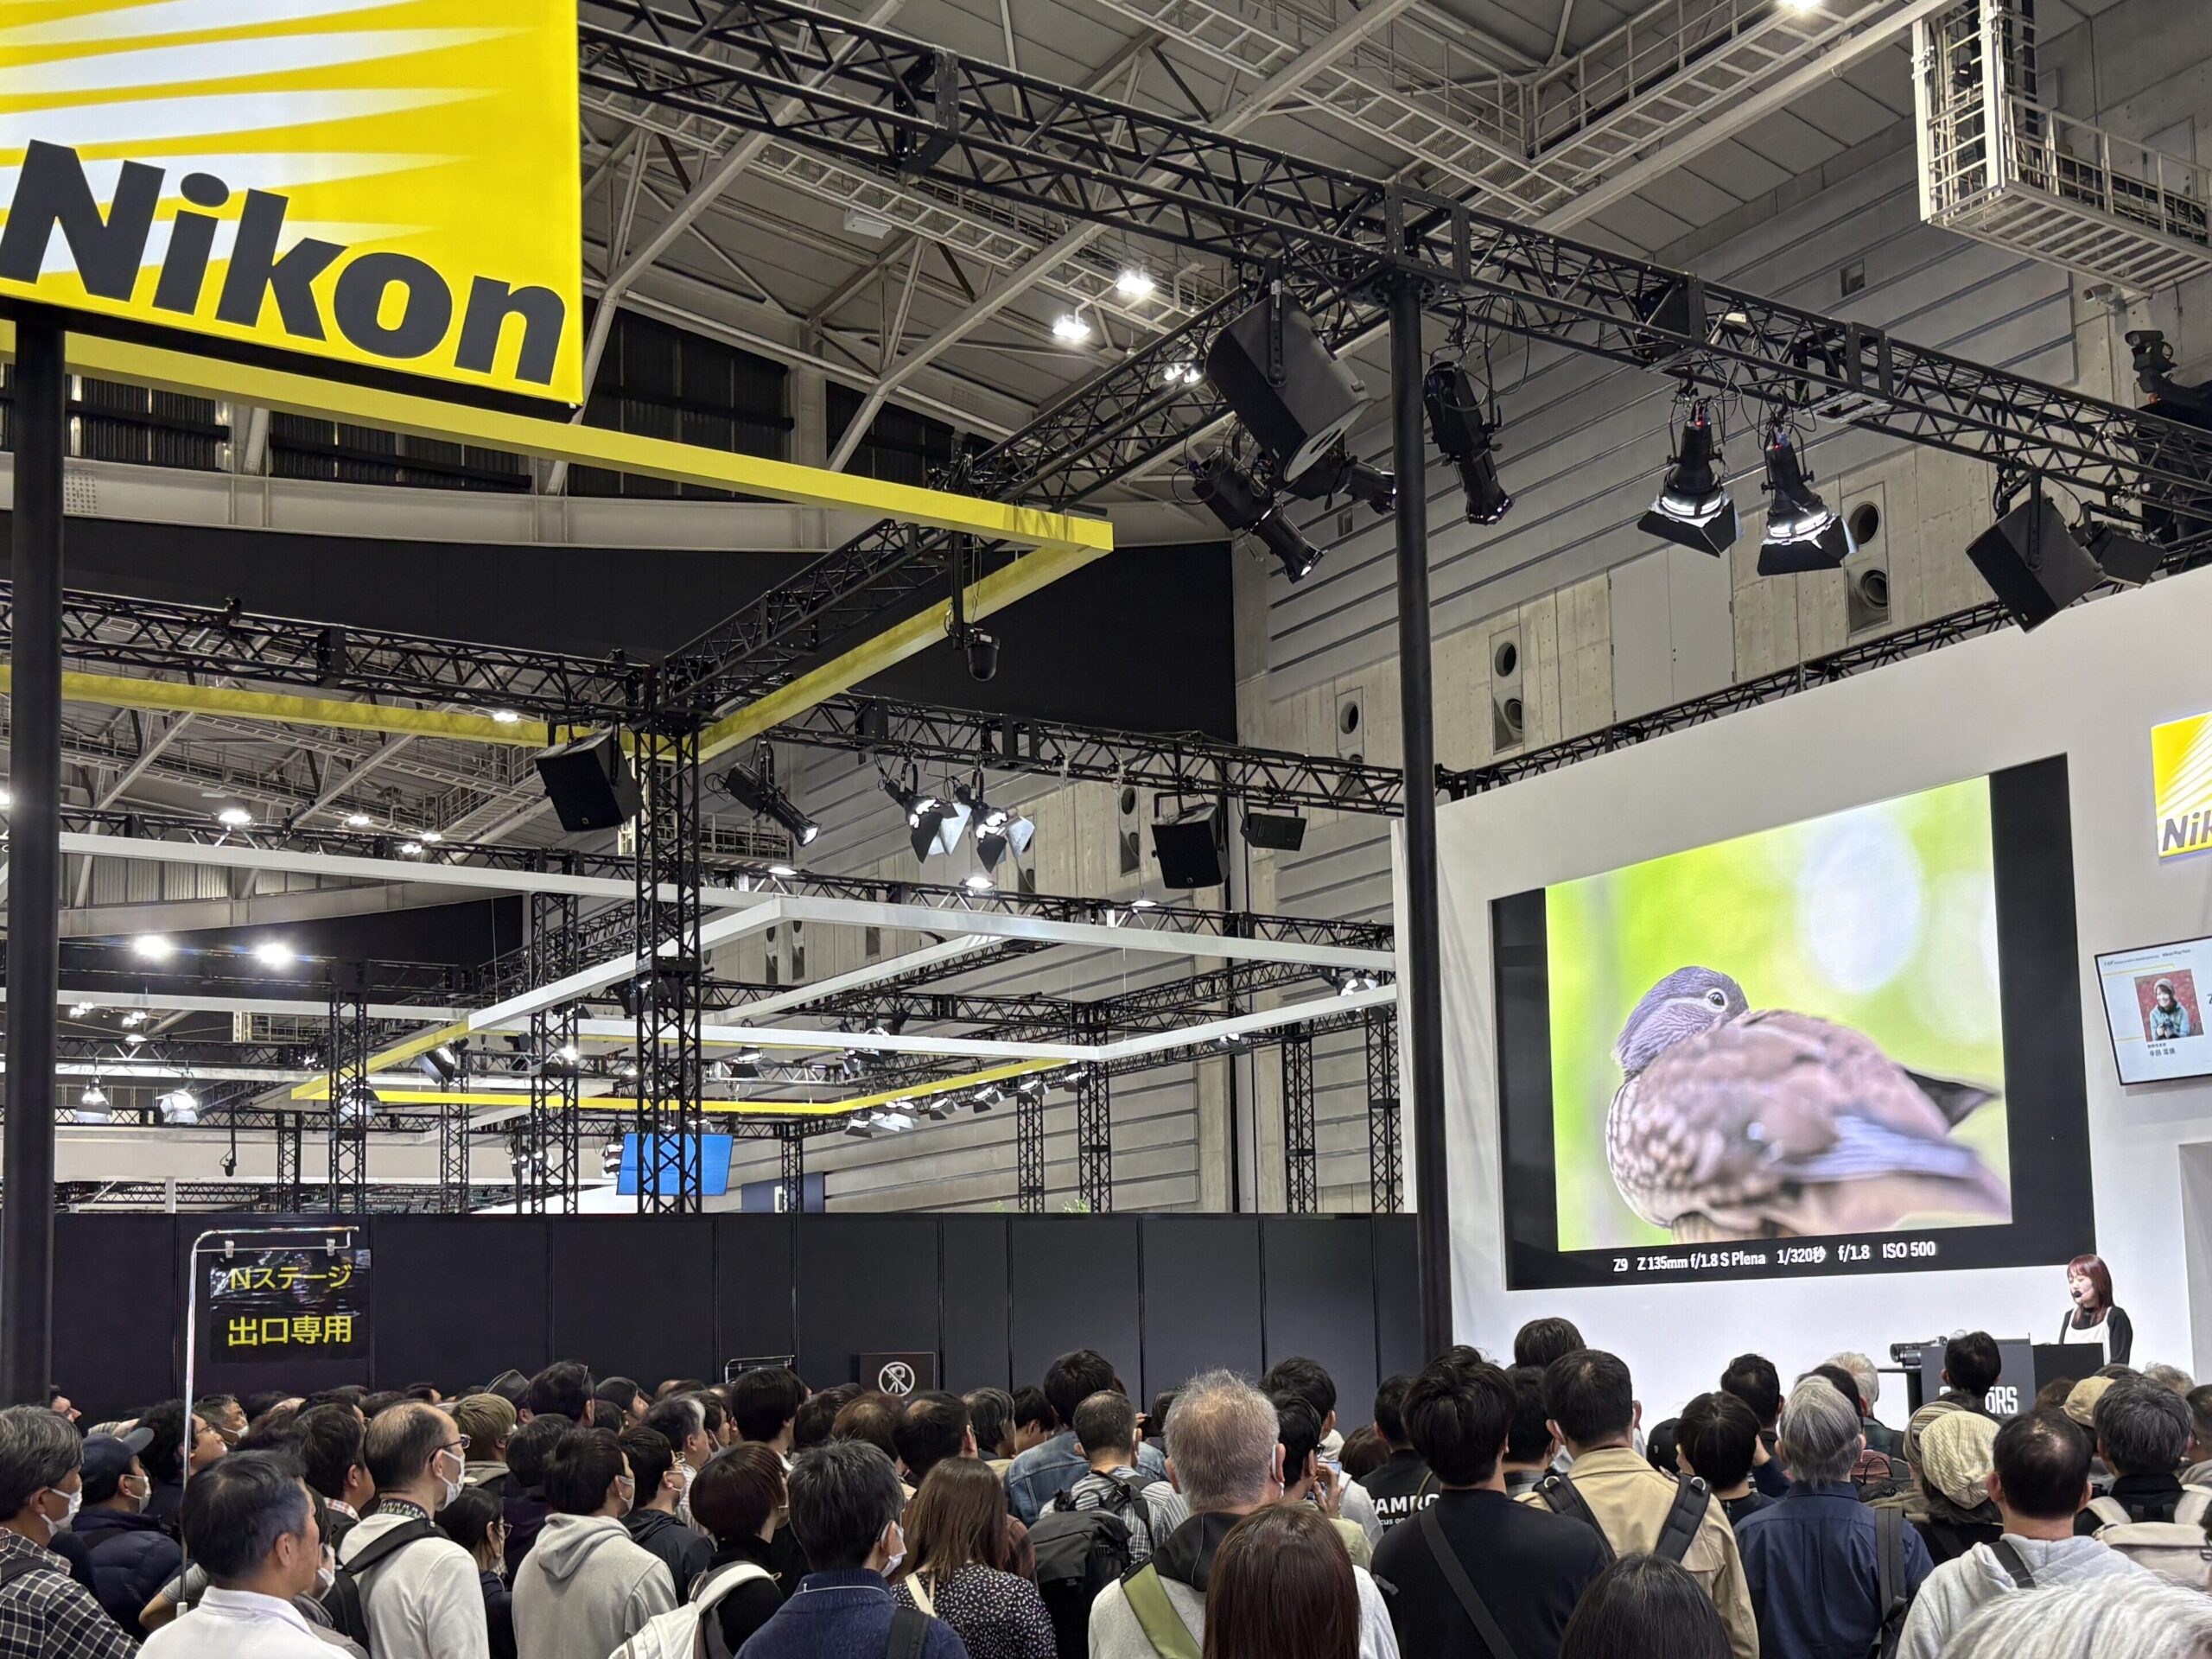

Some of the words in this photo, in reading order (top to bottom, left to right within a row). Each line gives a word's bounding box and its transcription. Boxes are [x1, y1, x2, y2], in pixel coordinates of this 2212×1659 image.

[0, 139, 566, 385] Nikon
[1612, 1258, 1629, 1272] Z9
[1637, 1257, 1647, 1271] Z
[1648, 1255, 1688, 1270] 135mm
[1690, 1253, 1719, 1269] f/1.8
[1719, 1252, 1729, 1267] S
[1731, 1250, 1766, 1266] Plena
[1838, 1244, 1871, 1262] f/1.8
[1883, 1243, 1908, 1259] ISO
[1910, 1241, 1936, 1257] 500
[231, 1264, 353, 1290] Nステージ
[228, 1315, 352, 1346] 出口専用
